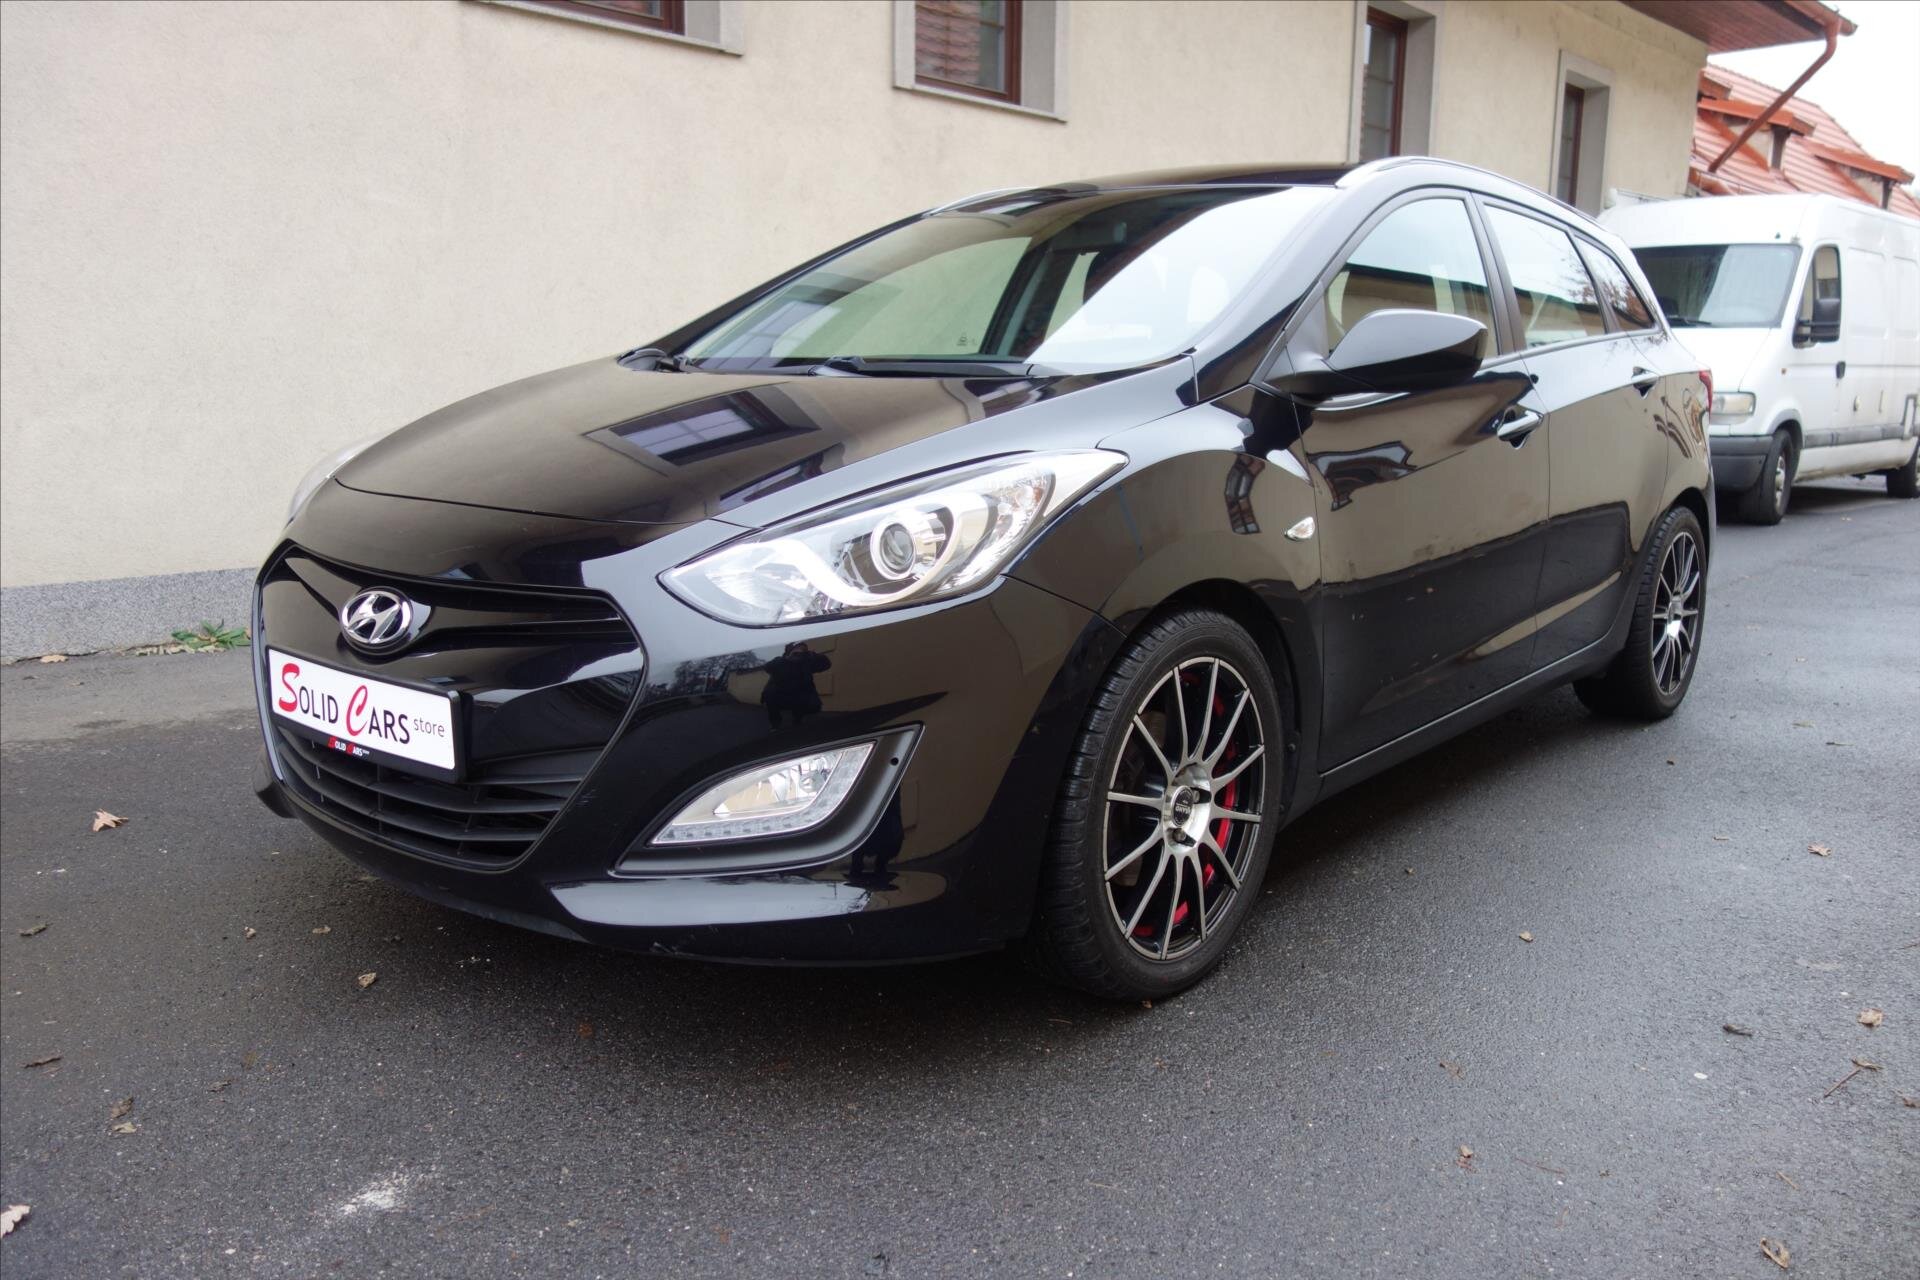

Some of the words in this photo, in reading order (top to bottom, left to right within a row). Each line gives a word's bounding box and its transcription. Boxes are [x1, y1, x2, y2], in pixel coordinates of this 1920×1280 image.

[278, 663, 339, 724] SOLID
[346, 685, 411, 745] CARS
[413, 716, 445, 737] store
